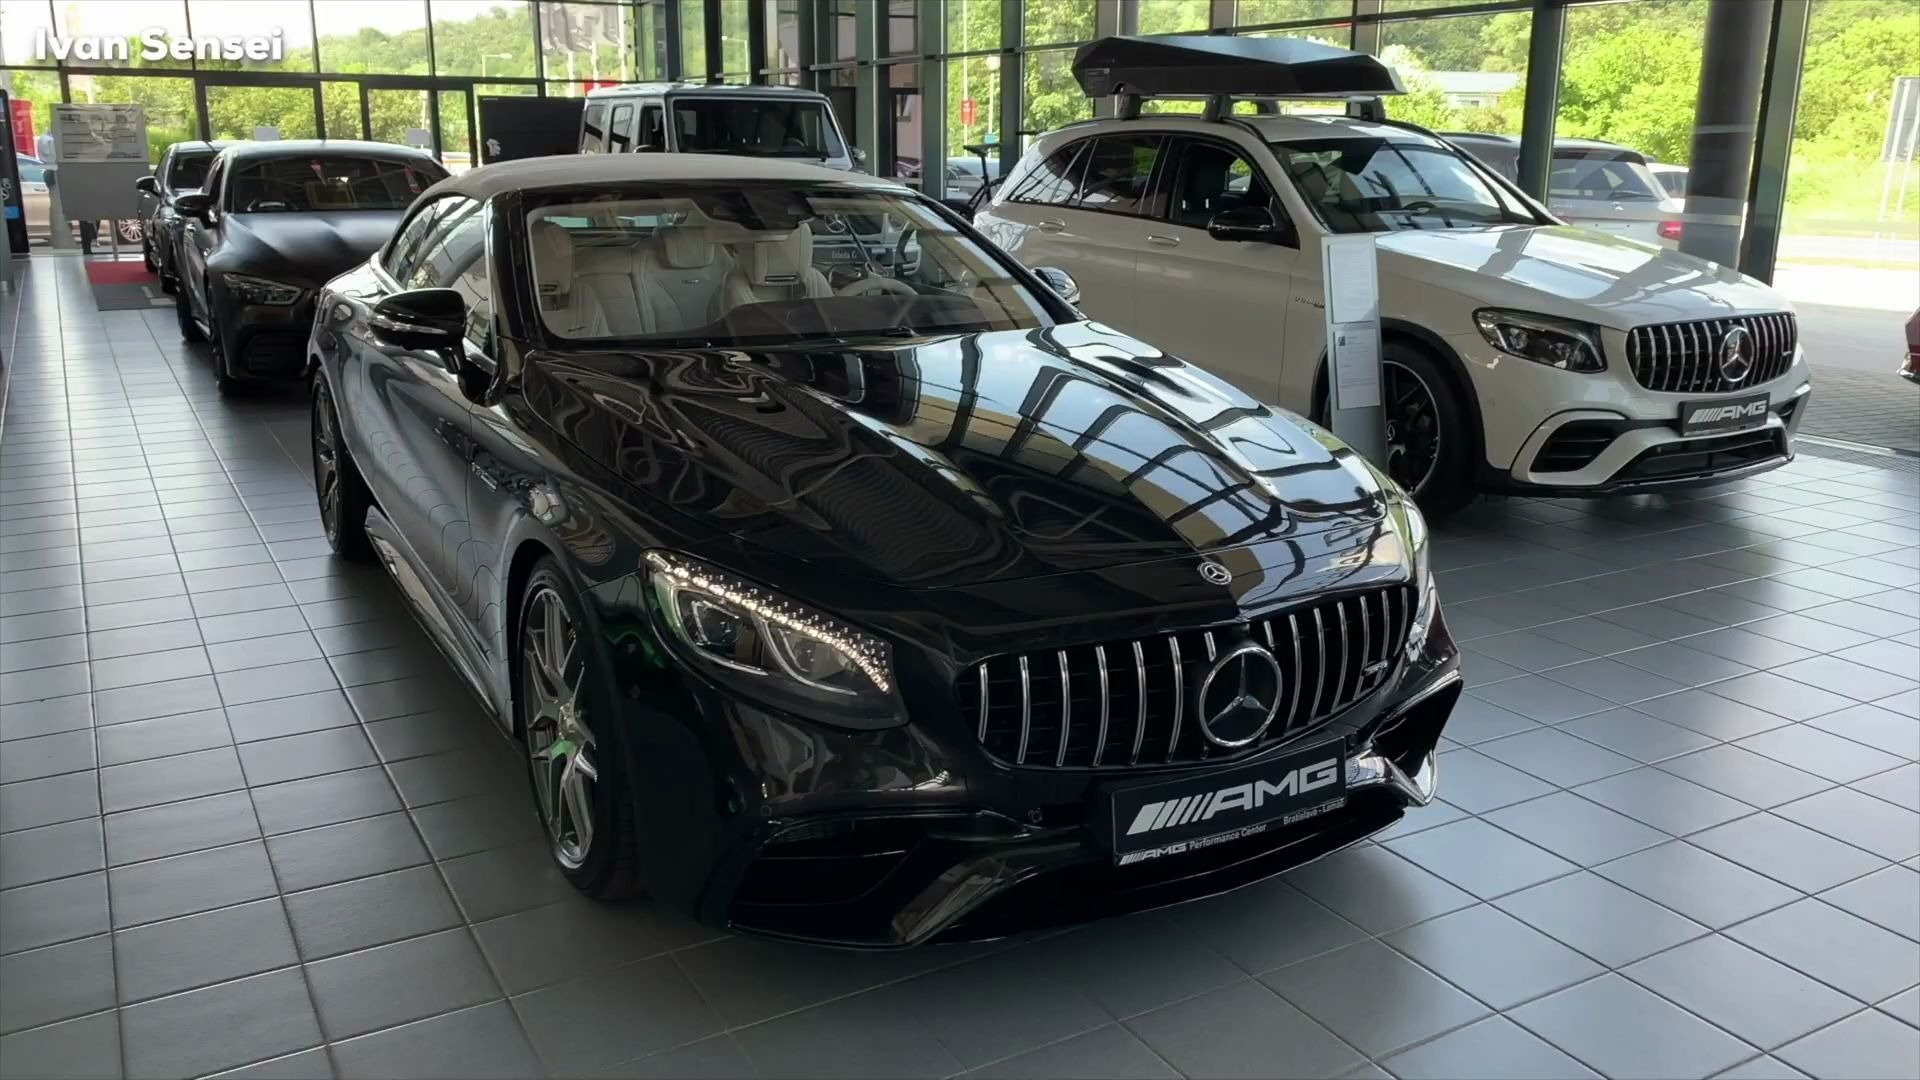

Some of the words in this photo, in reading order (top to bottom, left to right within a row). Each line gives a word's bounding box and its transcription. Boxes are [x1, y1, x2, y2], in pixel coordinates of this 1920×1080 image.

[1715, 400, 1767, 421] AMG
[1200, 757, 1338, 821] AMG
[1141, 842, 1187, 861] AMG
[1189, 832, 1240, 850] Performance
[1241, 824, 1267, 838] Center
